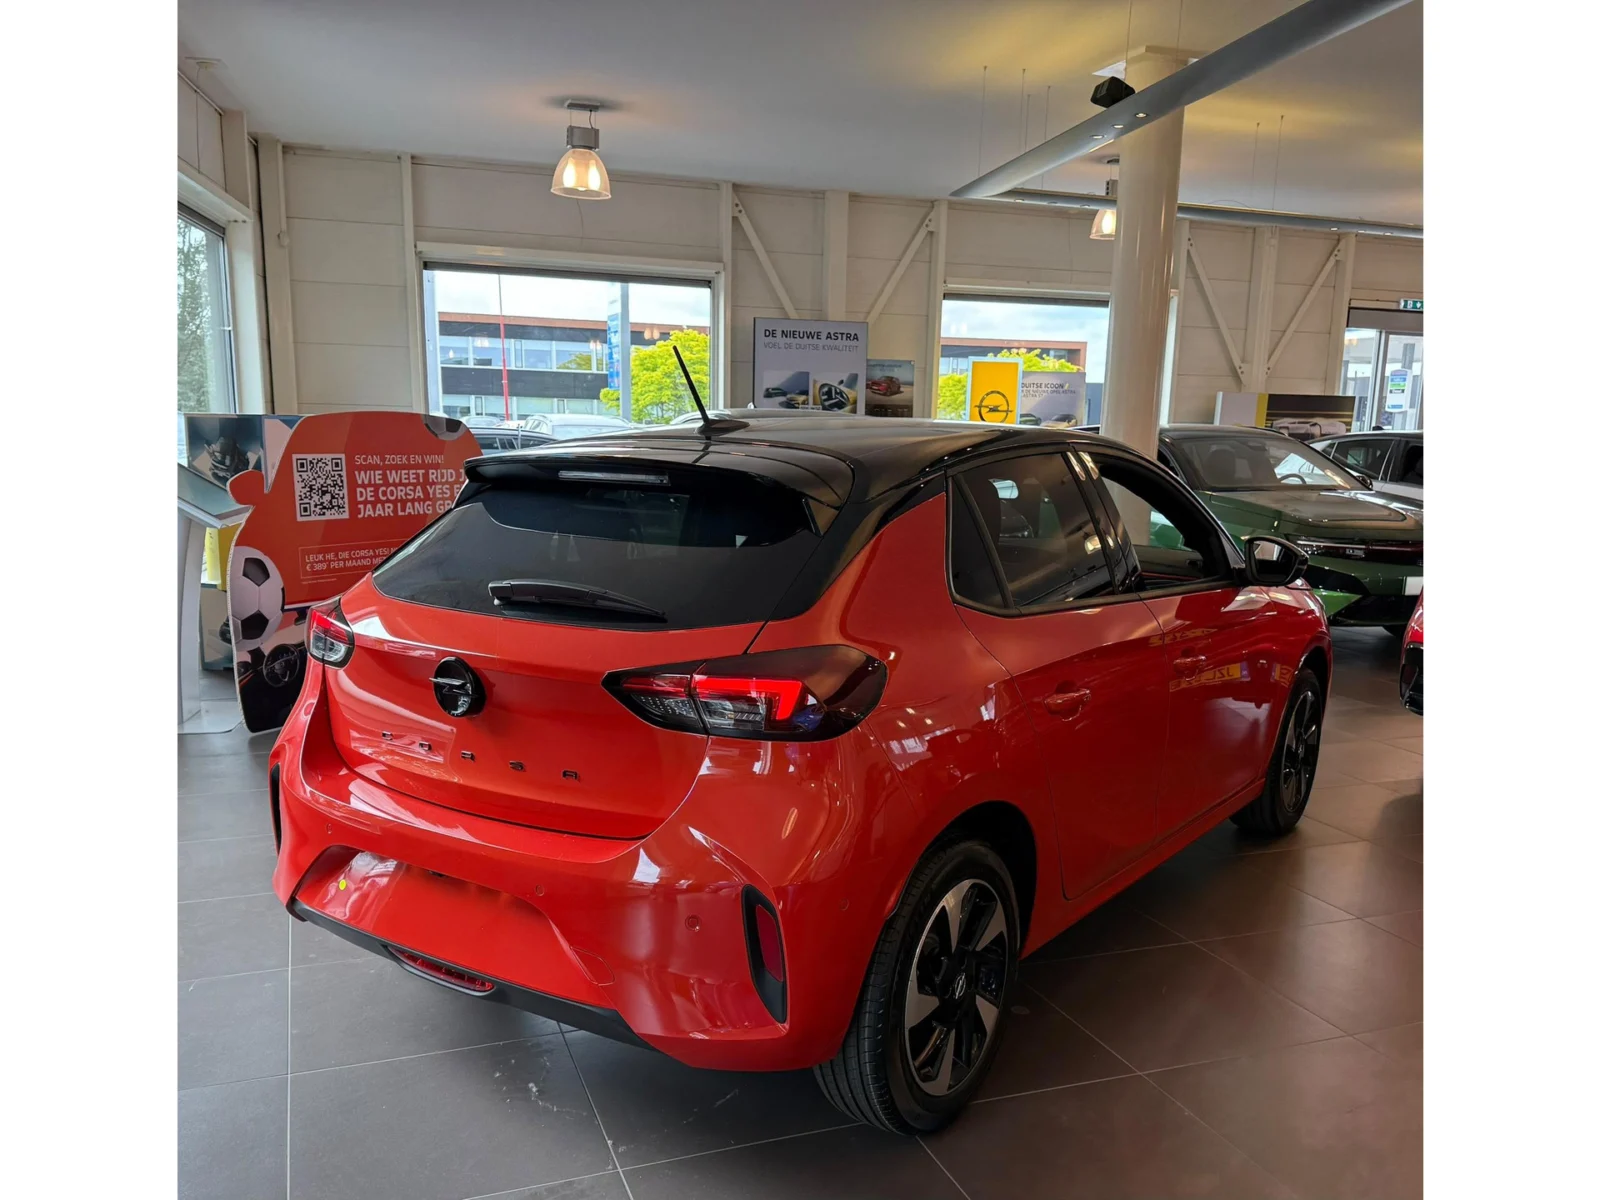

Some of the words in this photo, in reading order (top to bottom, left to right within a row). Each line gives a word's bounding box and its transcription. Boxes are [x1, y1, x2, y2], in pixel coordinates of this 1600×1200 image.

[764, 329, 777, 338] DE
[781, 330, 822, 340] NIEUWE
[826, 332, 859, 342] ASTRA
[764, 342, 781, 350] VOEL
[796, 343, 820, 351] DUITSE
[822, 344, 859, 353] KWALITEIT
[355, 455, 383, 466] SCAN,
[385, 455, 407, 465] ZOEK
[410, 455, 421, 464] EN
[424, 454, 444, 464] WIN!
[355, 471, 383, 484] WIE
[387, 470, 425, 483] WEET
[429, 469, 456, 482] RIJD
[357, 487, 375, 501] DE
[379, 485, 424, 500] CORSA
[427, 484, 450, 498] YES
[357, 503, 394, 518] JAAR
[397, 501, 433, 515] LANG
[305, 554, 324, 562] LEUK
[325, 552, 337, 561] HE,
[338, 550, 350, 559] DIE
[330, 560, 344, 568] PER
[345, 558, 371, 567] MAAND
[382, 731, 579, 780] CORSA
